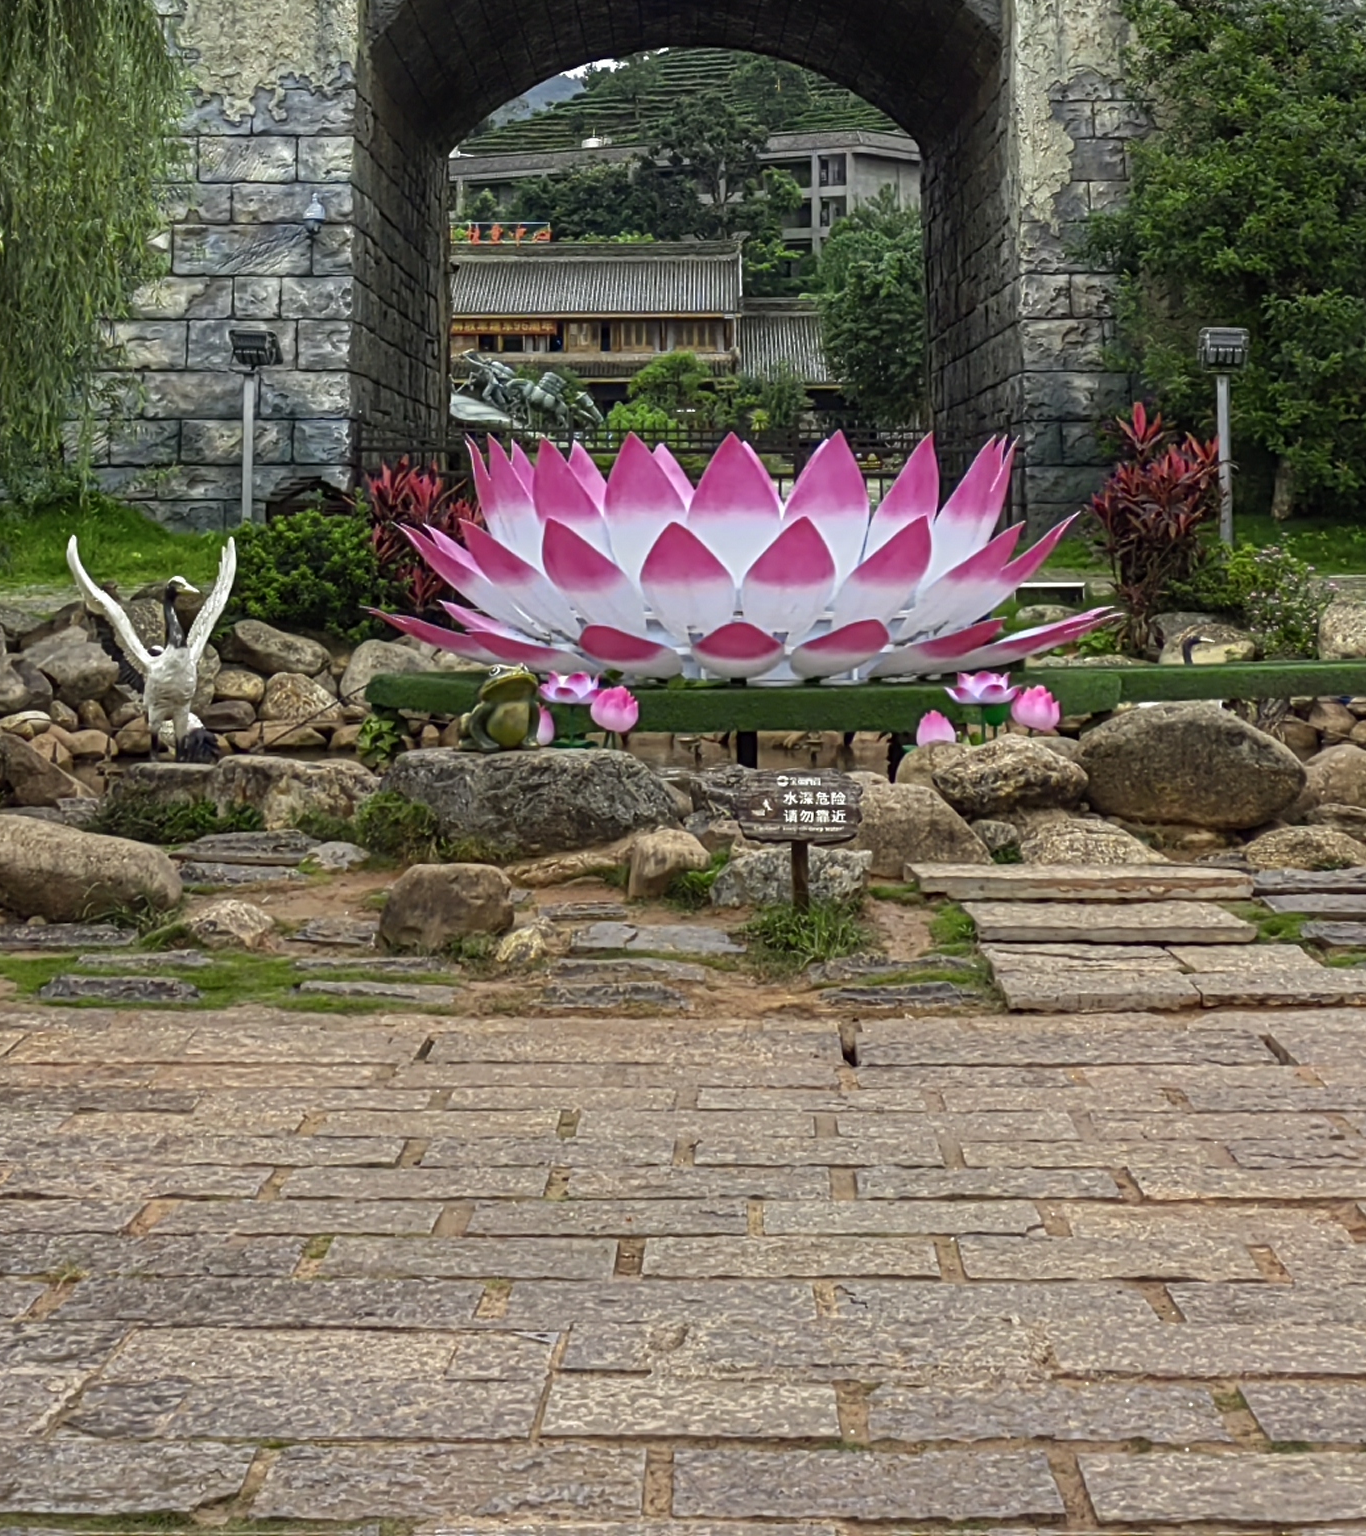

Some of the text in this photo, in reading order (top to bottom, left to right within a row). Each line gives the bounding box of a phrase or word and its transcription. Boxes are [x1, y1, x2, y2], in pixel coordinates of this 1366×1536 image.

[782, 790, 847, 806] 水深危险
[782, 809, 847, 823] 请勿靠近
